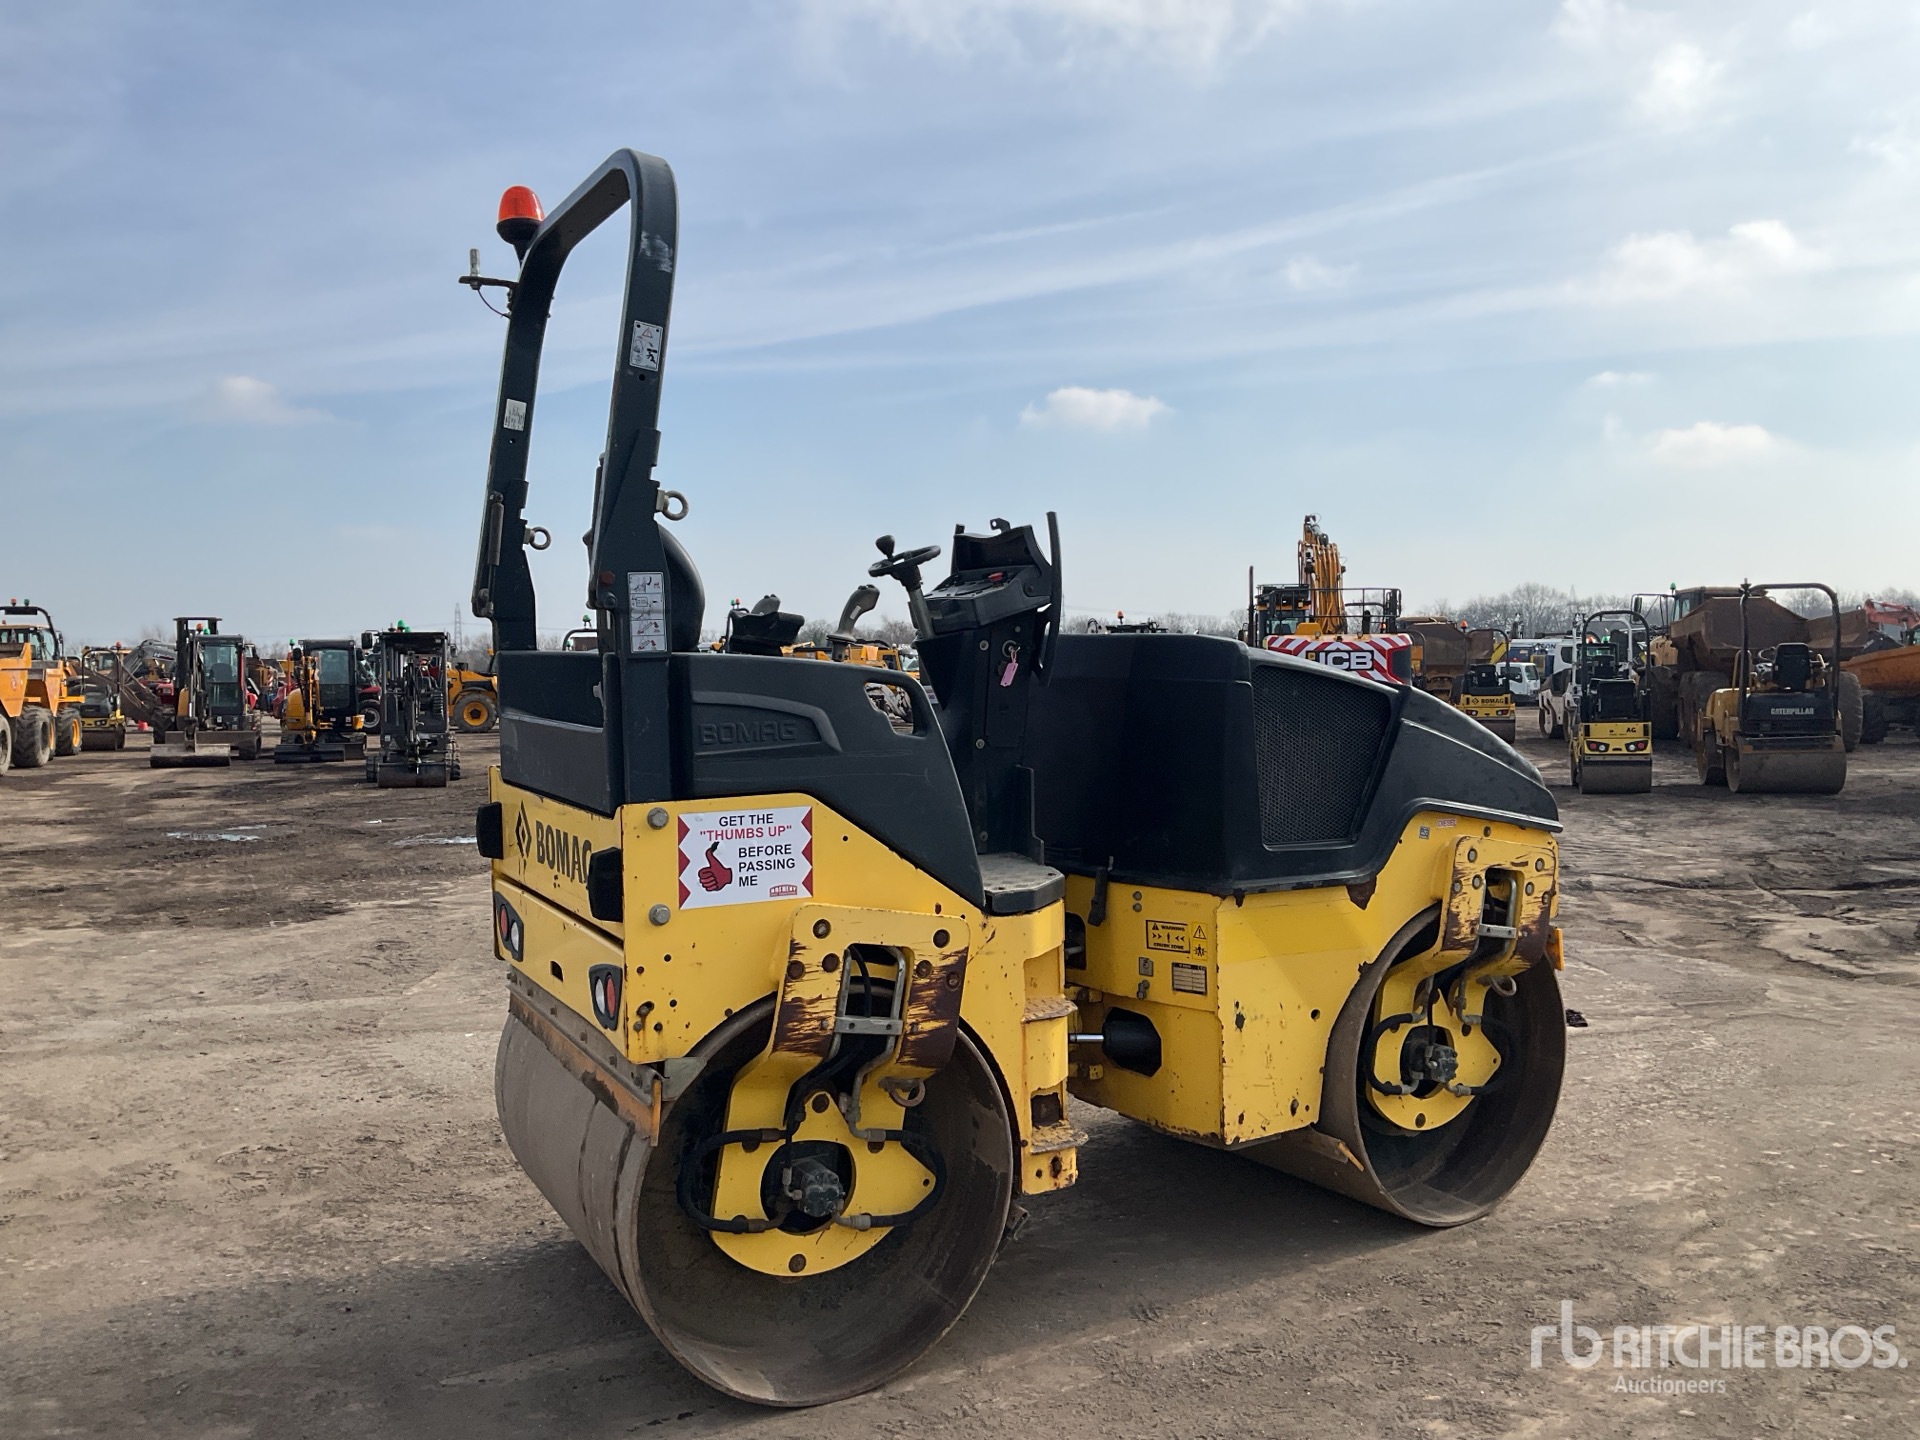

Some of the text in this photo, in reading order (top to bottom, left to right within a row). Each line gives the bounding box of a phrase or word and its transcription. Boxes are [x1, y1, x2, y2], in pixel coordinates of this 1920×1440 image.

[1770, 707, 1815, 715] CATERPILLAR
[700, 720, 797, 744] BOMAG
[719, 813, 774, 827] GET THE
[700, 825, 792, 842] "THUMBS UP"
[738, 844, 792, 858] BEFORE
[738, 858, 796, 873] PASSING
[738, 875, 758, 887] ME
